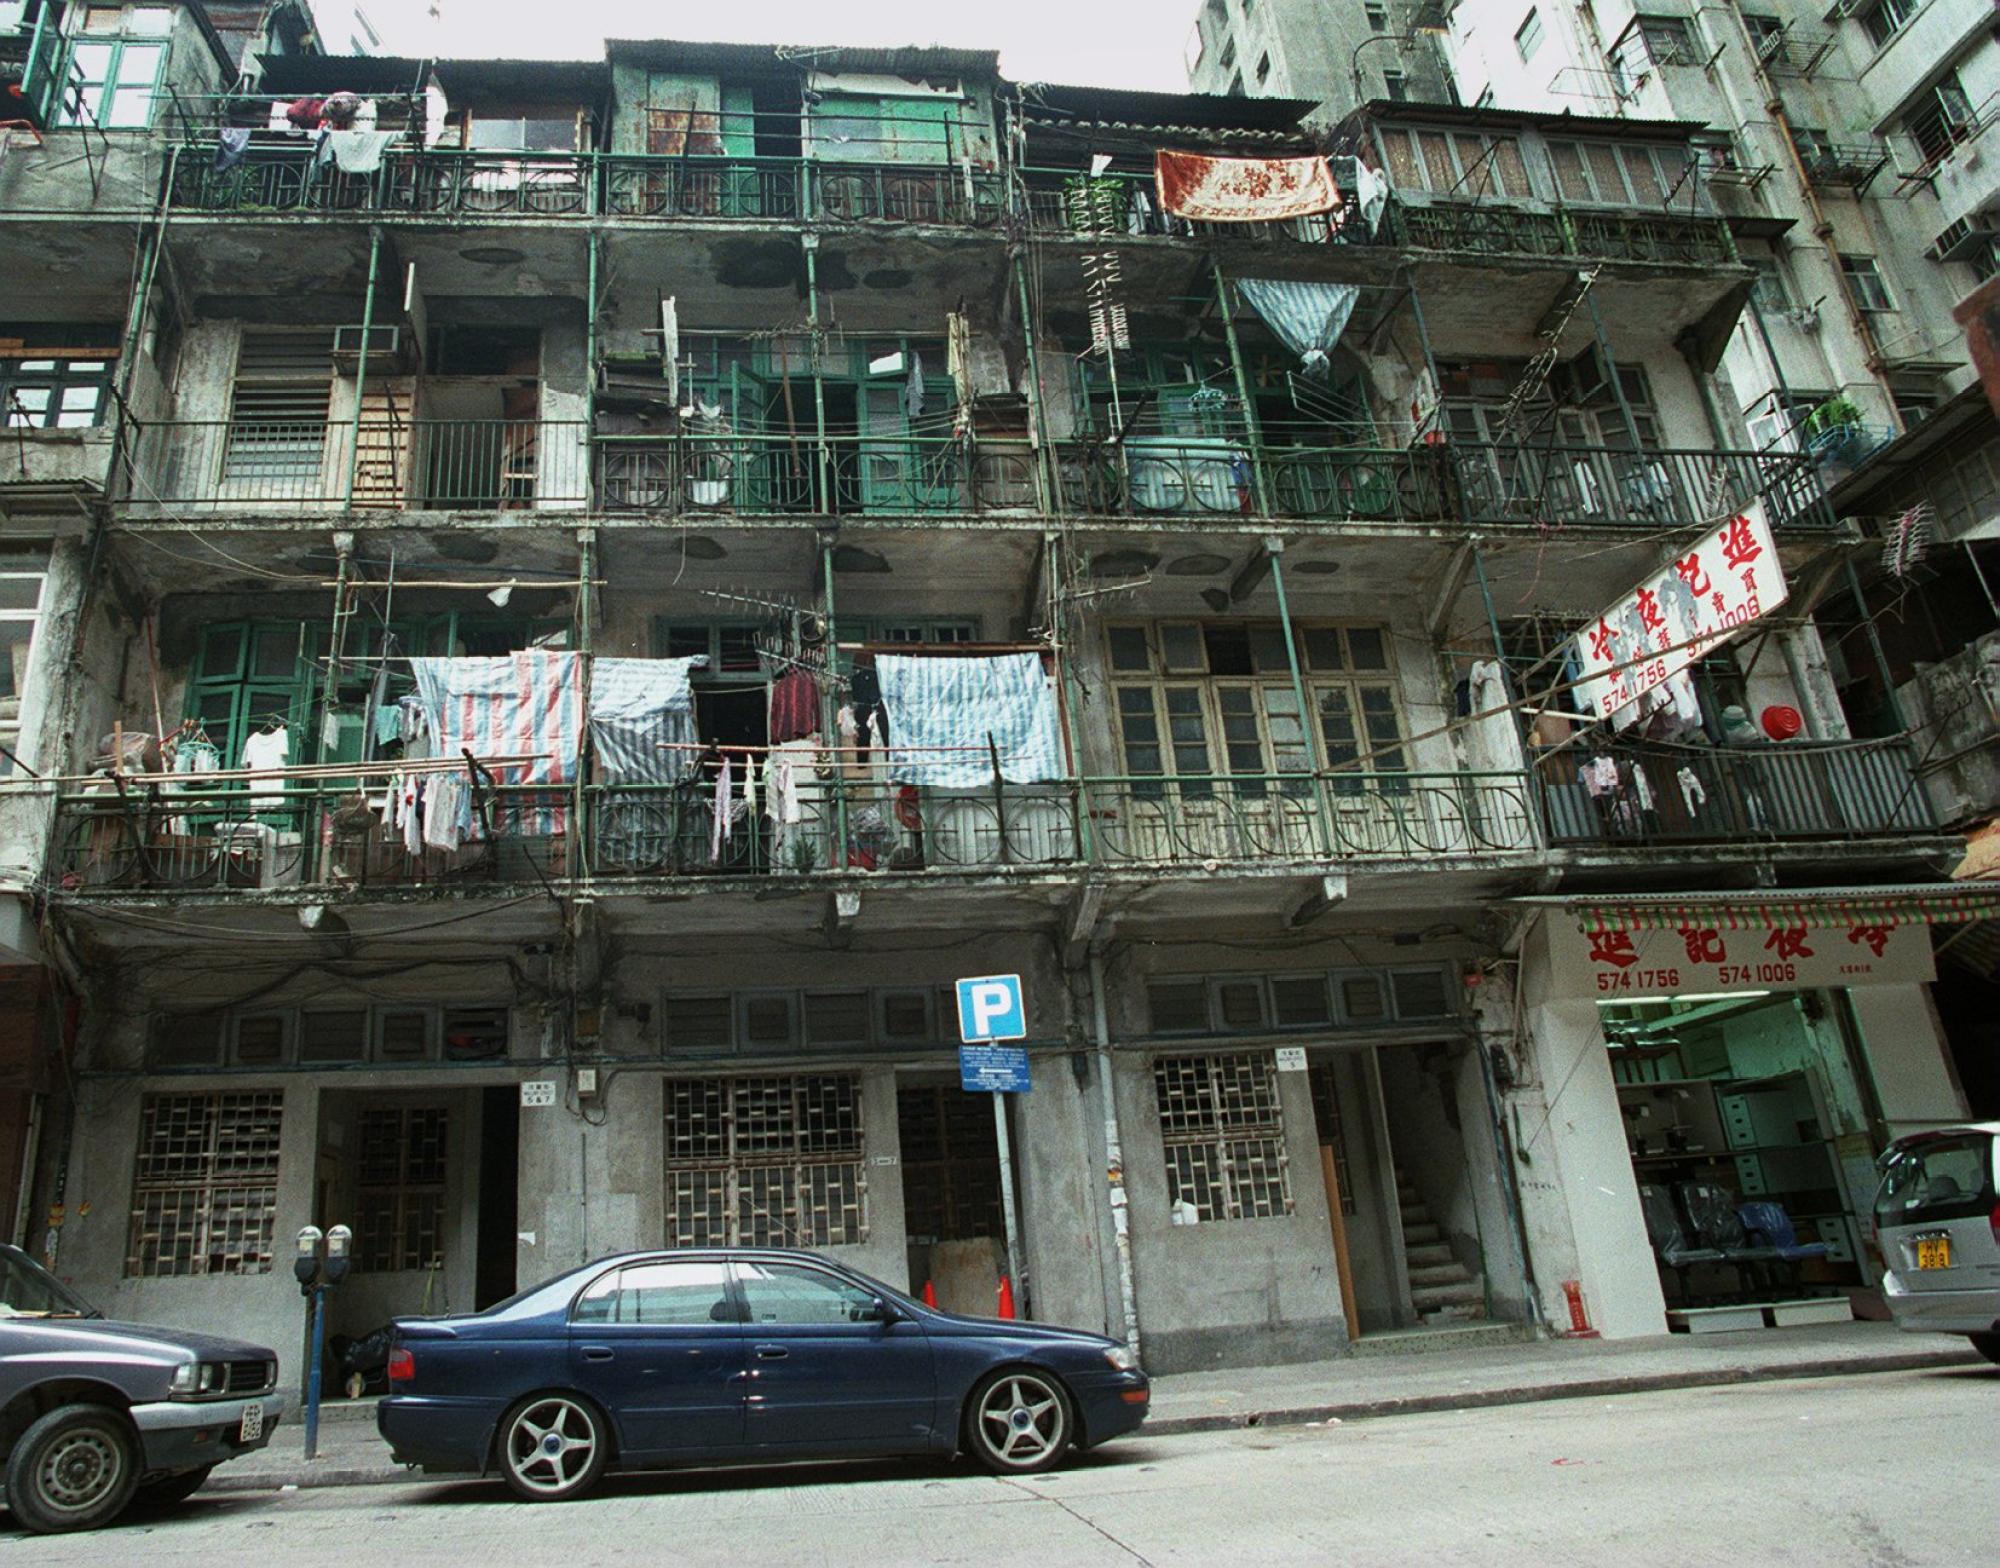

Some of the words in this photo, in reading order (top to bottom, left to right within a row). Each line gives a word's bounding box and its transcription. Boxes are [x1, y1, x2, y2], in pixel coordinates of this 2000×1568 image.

[1719, 597, 1760, 630] 1006
[1602, 687, 1628, 713] 574
[1631, 659, 1667, 697] 1756
[1597, 971, 1631, 991] 574
[1637, 968, 1680, 988] 1756
[1719, 965, 1751, 984] 574
[1757, 963, 1796, 982] 1006
[971, 983, 1012, 1036] P
